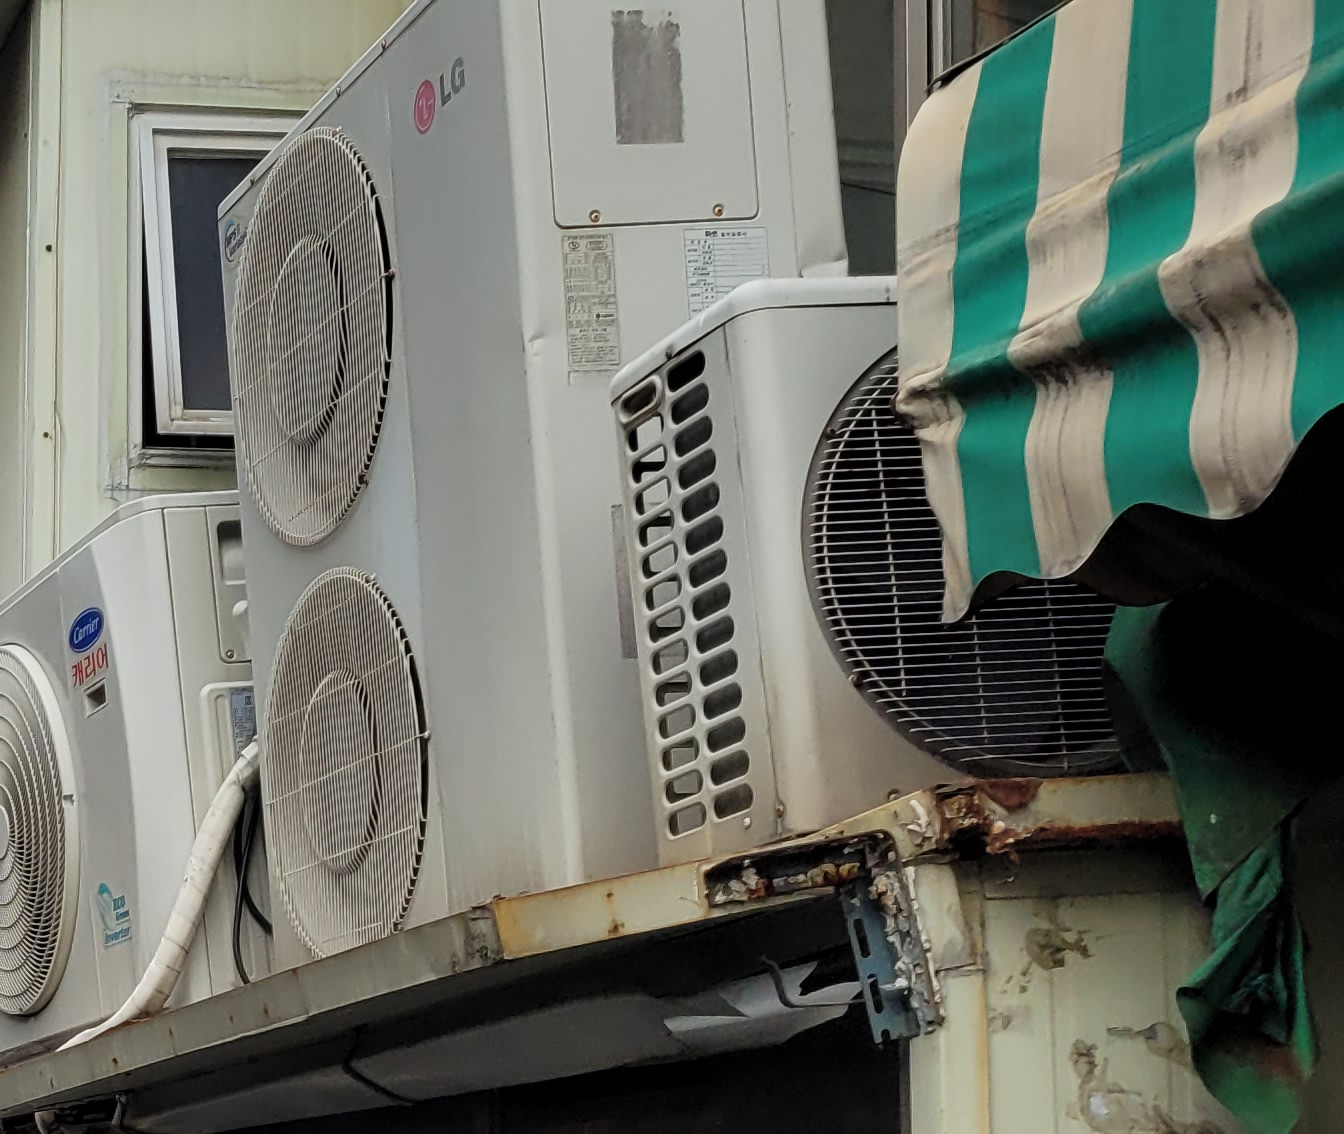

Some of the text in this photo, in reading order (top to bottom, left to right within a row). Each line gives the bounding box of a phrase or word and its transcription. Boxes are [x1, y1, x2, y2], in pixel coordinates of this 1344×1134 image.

[438, 57, 466, 109] LG
[72, 615, 100, 646] Carrier
[72, 644, 109, 687] 캐리어
